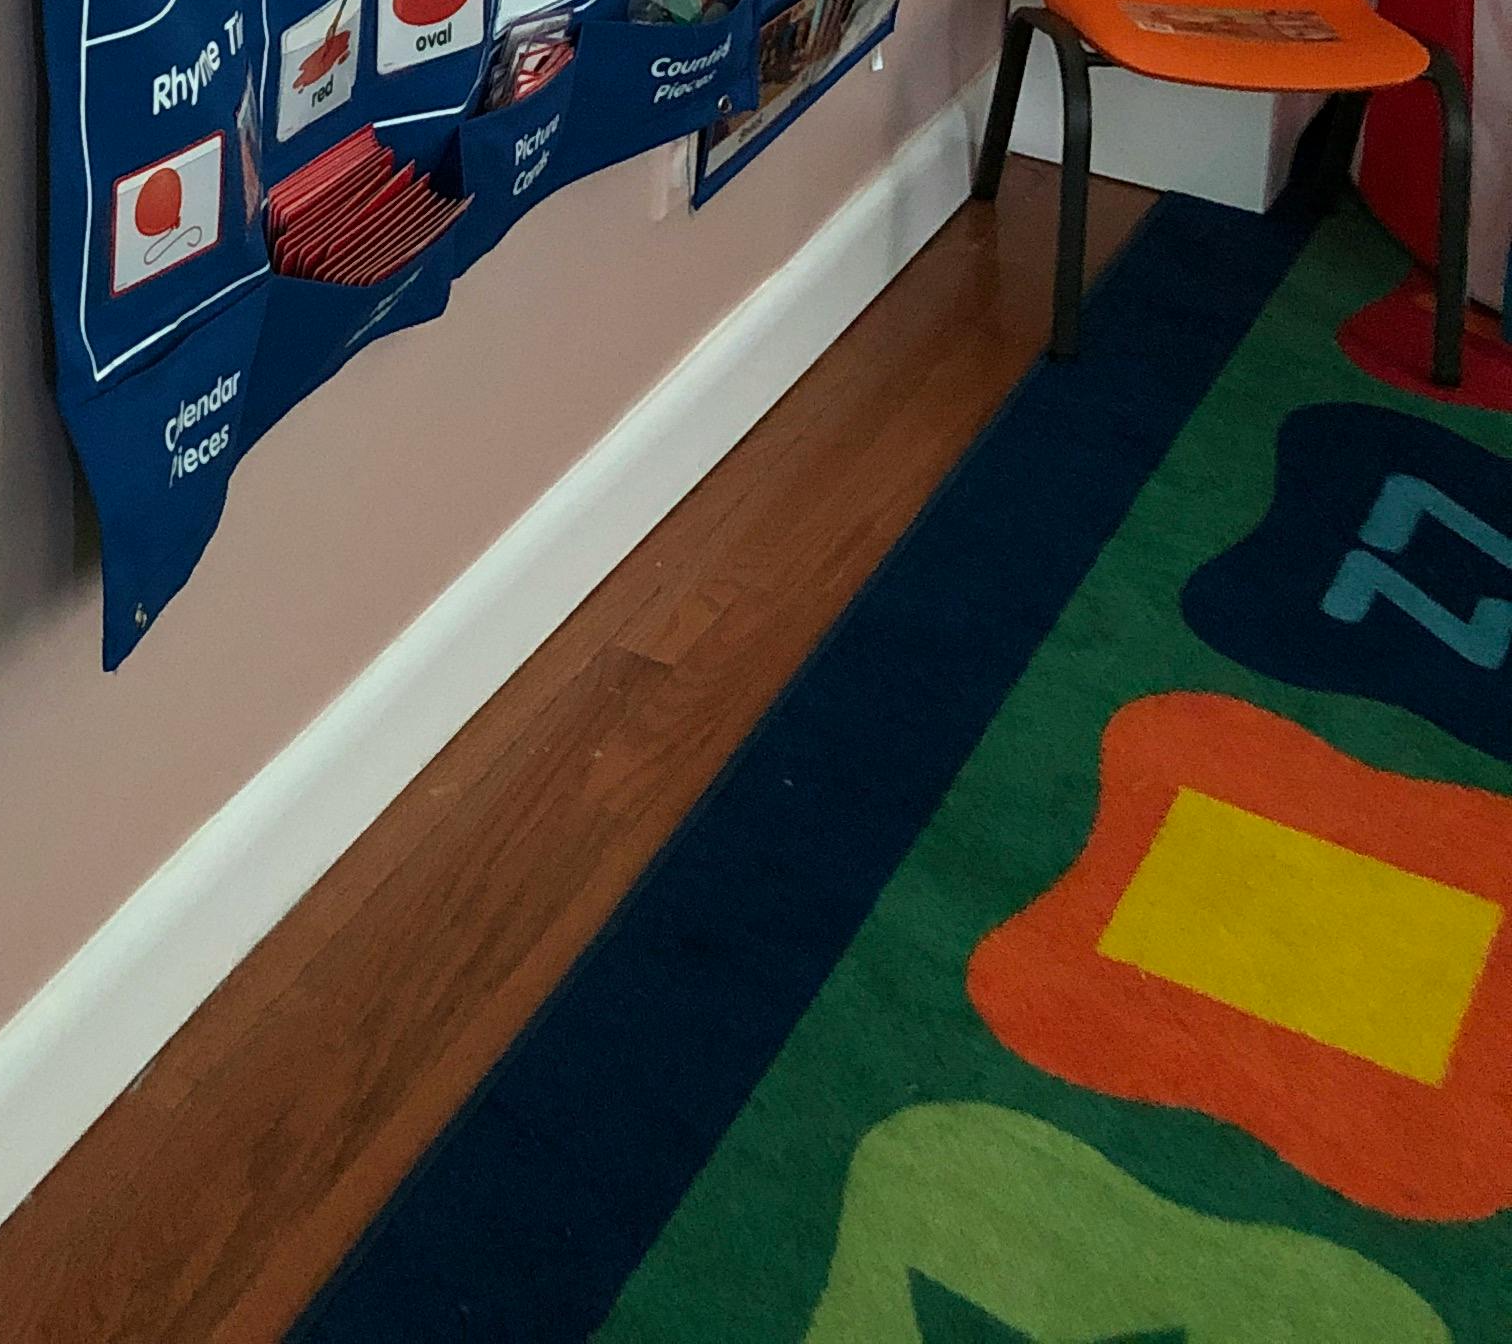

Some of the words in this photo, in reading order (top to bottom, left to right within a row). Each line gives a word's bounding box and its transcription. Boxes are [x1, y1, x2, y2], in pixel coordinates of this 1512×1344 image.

[414, 22, 453, 54] oval
[311, 75, 334, 109] red
[164, 369, 242, 453] Clendar
